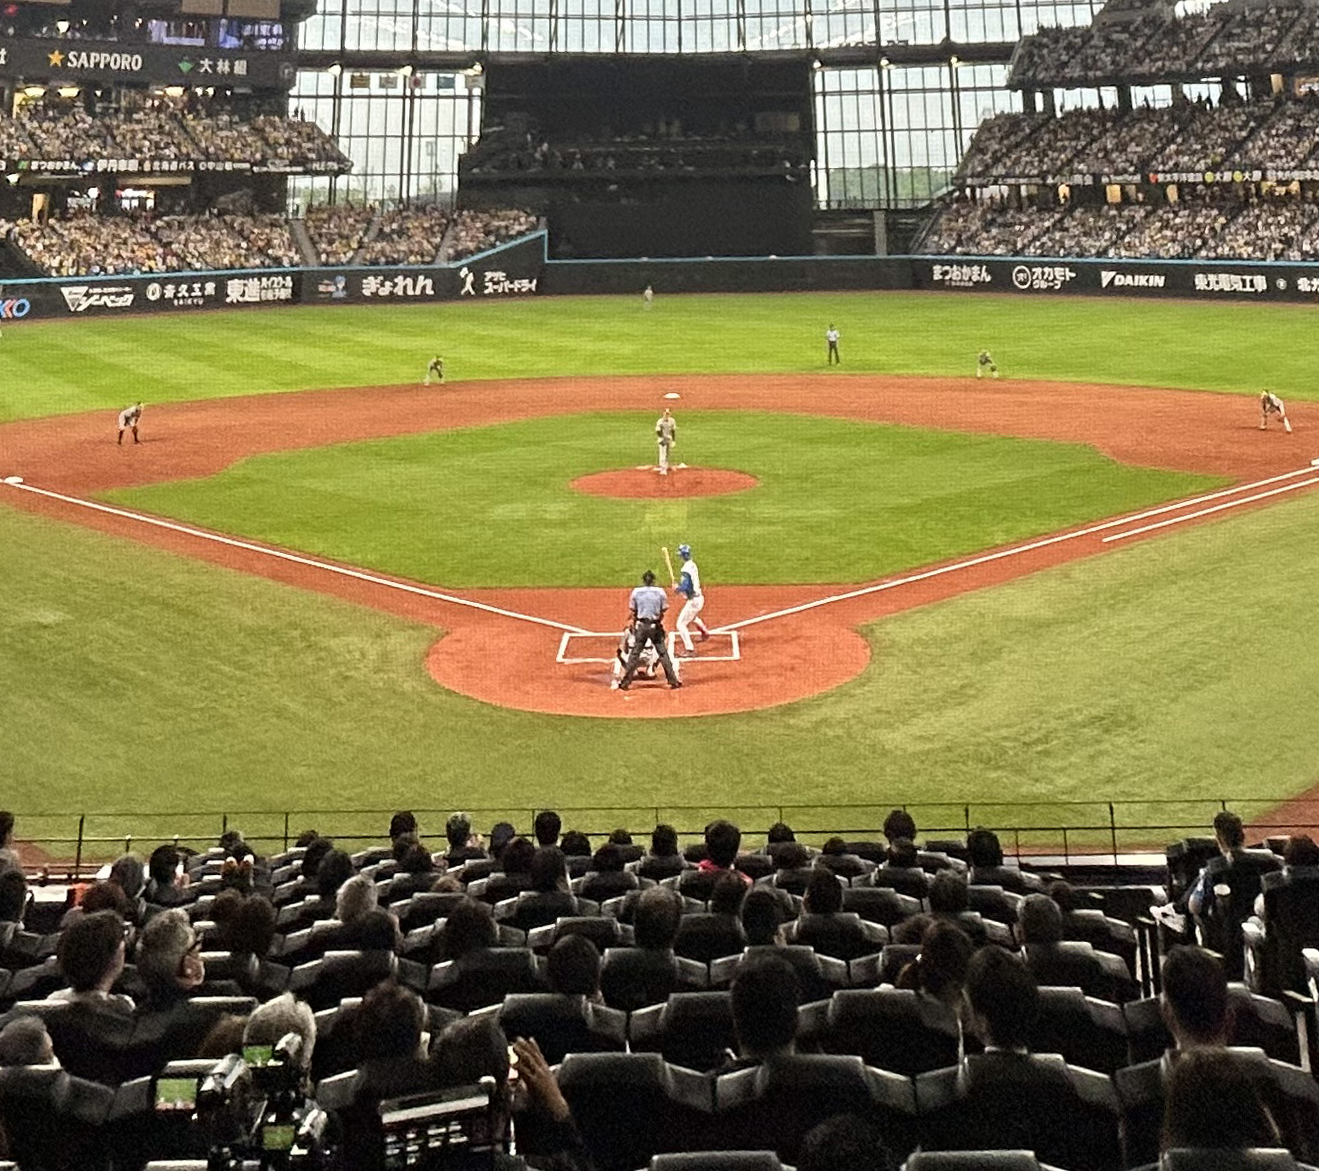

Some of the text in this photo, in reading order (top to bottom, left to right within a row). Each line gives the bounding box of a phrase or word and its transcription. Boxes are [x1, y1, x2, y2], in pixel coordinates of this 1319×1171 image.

[67, 50, 143, 72] SAPPORO
[199, 57, 248, 77] 大林組
[1032, 267, 1077, 281] オカモト
[1114, 275, 1166, 288] DAIKIN
[226, 278, 261, 303] 東進
[361, 274, 436, 297] ぎょれん
[484, 279, 537, 294] スーパードライ
